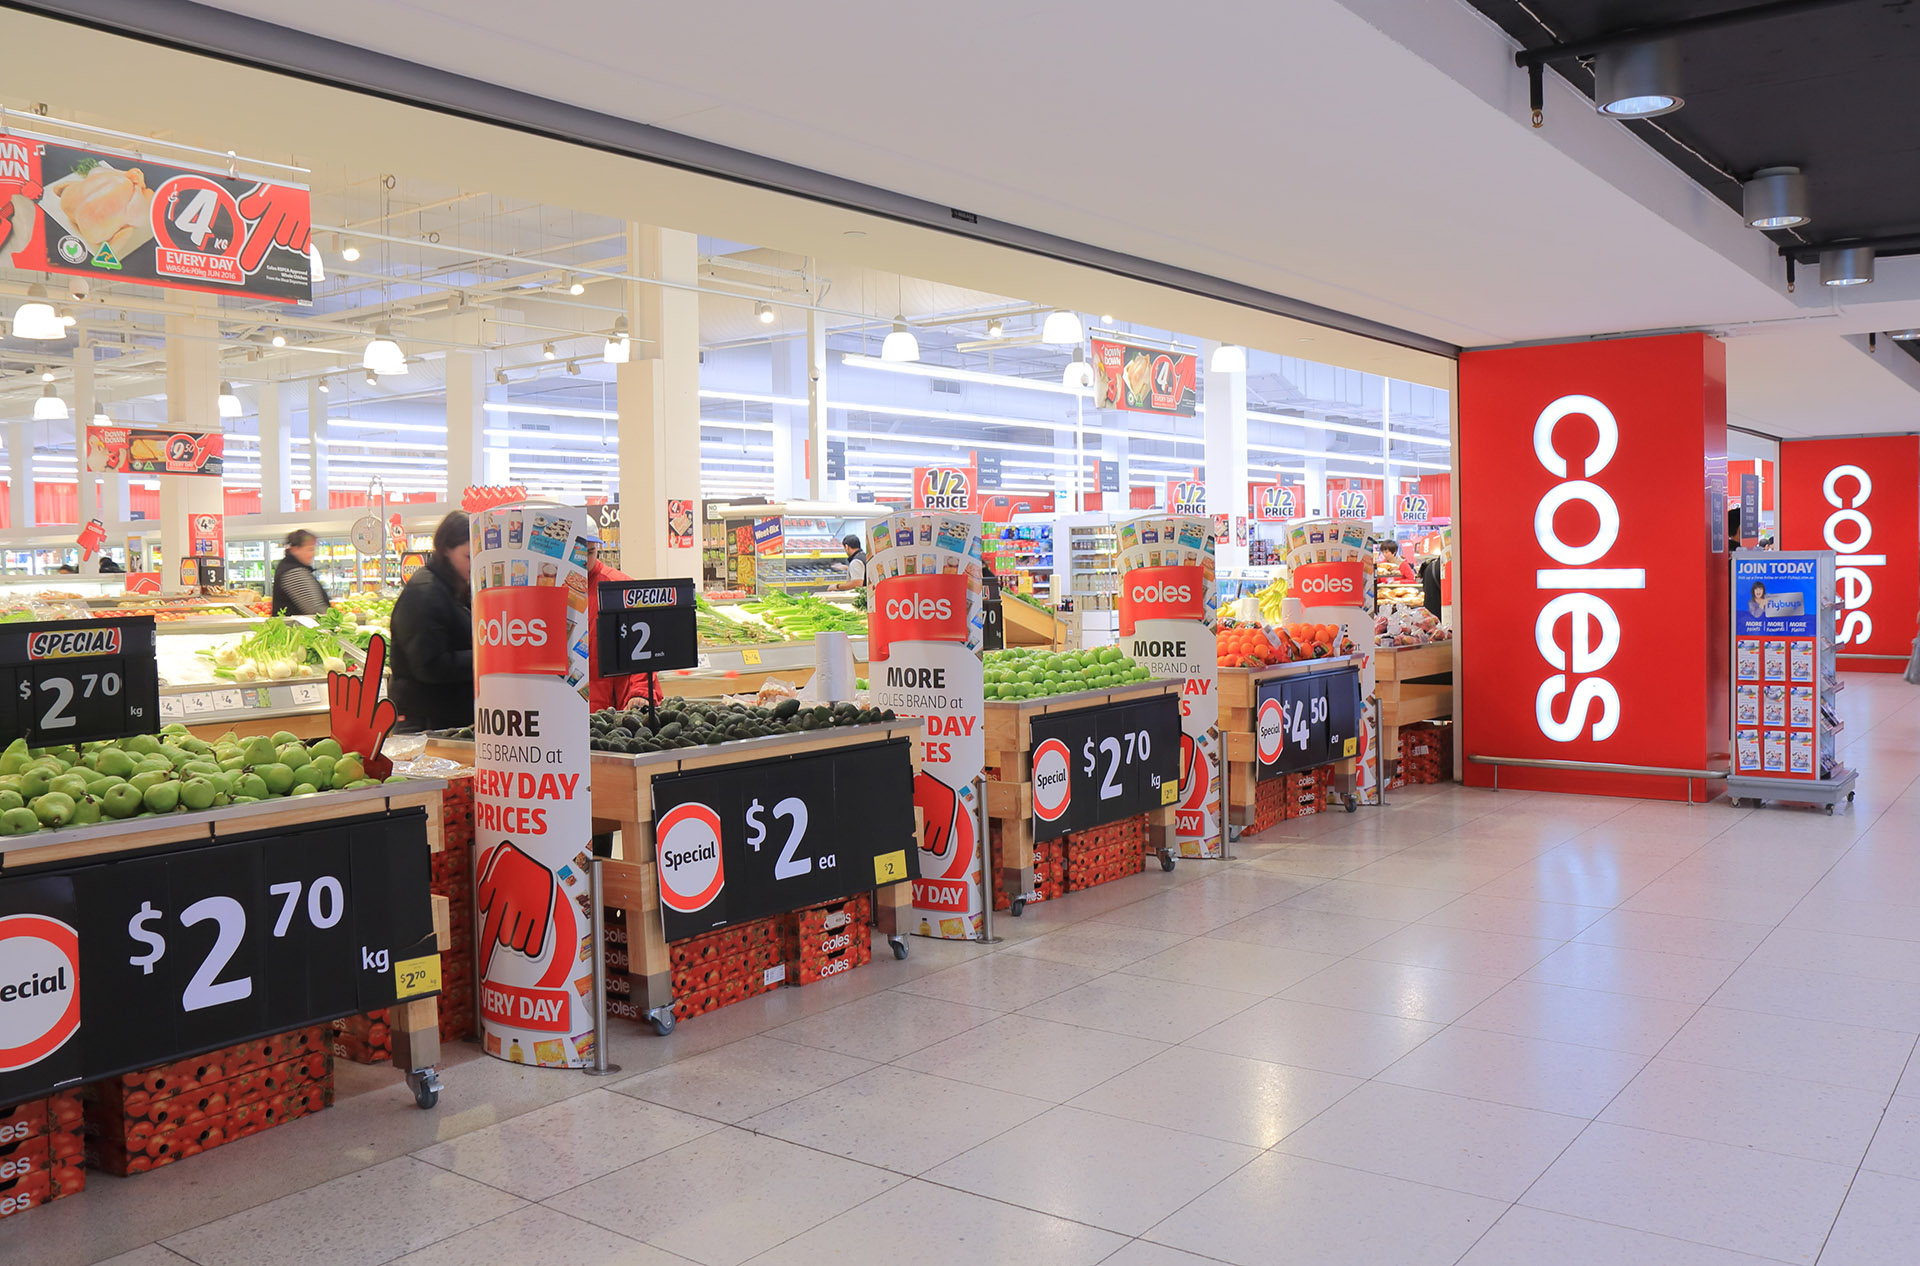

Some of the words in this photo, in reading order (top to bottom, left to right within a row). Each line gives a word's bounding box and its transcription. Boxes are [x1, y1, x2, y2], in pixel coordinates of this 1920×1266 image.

[166, 251, 206, 267] EVERY
[209, 259, 234, 271] DAY
[207, 269, 220, 278] JUN
[220, 271, 236, 280] 2016
[928, 469, 965, 495] 1/2
[926, 495, 967, 509] PRICE
[1179, 482, 1205, 503] 1/2
[1265, 488, 1292, 507] 1/2
[1341, 491, 1365, 508] 1/2
[1265, 506, 1294, 517] PRICE
[1340, 509, 1366, 517] PRICE
[1404, 496, 1427, 512] 1/2
[1403, 512, 1427, 520] PRICE
[1823, 464, 1887, 645] coles
[1534, 394, 1645, 742] coles
[1738, 562, 1767, 574] JOIN
[1769, 562, 1814, 574] TODAY
[1132, 580, 1191, 604] coles
[1301, 574, 1353, 593] coles
[626, 587, 674, 606] SPECIAL
[1768, 599, 1801, 611] flybuys
[886, 593, 952, 621] coles
[478, 611, 548, 647] coles
[32, 630, 117, 656] SPECIAL
[1133, 641, 1187, 658] MORE
[887, 666, 945, 689] MORE
[1151, 662, 1188, 674] BRAND
[1190, 664, 1201, 674] at
[878, 692, 905, 707] COLES
[906, 694, 947, 709] BRAND
[950, 697, 964, 709] at
[130, 704, 143, 717] kg
[478, 707, 540, 737] MORE
[927, 715, 976, 737] DAY
[1260, 723, 1281, 739] Special
[1331, 734, 1339, 744] ea
[494, 744, 542, 763] BRAND
[546, 748, 563, 763] at
[518, 772, 580, 800] DAY
[1037, 768, 1067, 790] Special
[1151, 773, 1161, 790] kg
[1299, 776, 1315, 786] coles
[1299, 792, 1315, 803] coles
[477, 801, 548, 835] PRICES
[1299, 806, 1316, 817] coles
[664, 841, 717, 871] Special
[818, 853, 837, 870] ea
[928, 885, 963, 905] DAY
[822, 934, 850, 952] coles
[362, 946, 390, 974] kg
[821, 958, 849, 977] coles
[519, 996, 564, 1022] DAY
